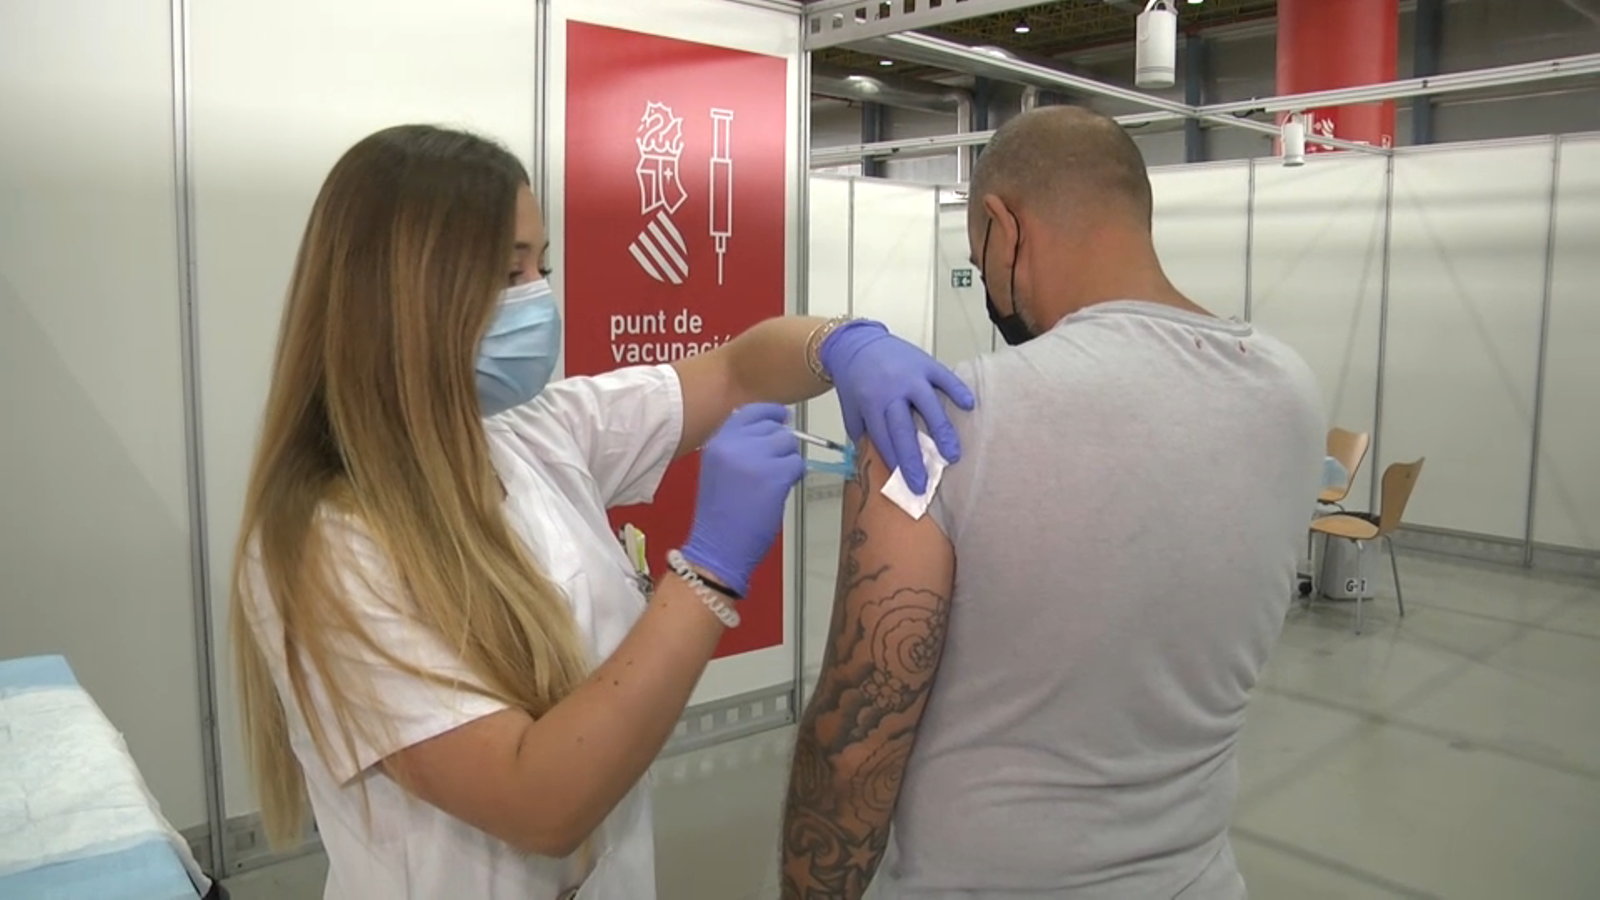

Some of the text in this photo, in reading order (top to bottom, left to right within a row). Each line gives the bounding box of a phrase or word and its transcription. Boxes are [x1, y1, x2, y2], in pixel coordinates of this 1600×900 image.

[610, 308, 703, 341] punt de
[611, 334, 731, 363] vacunaci
